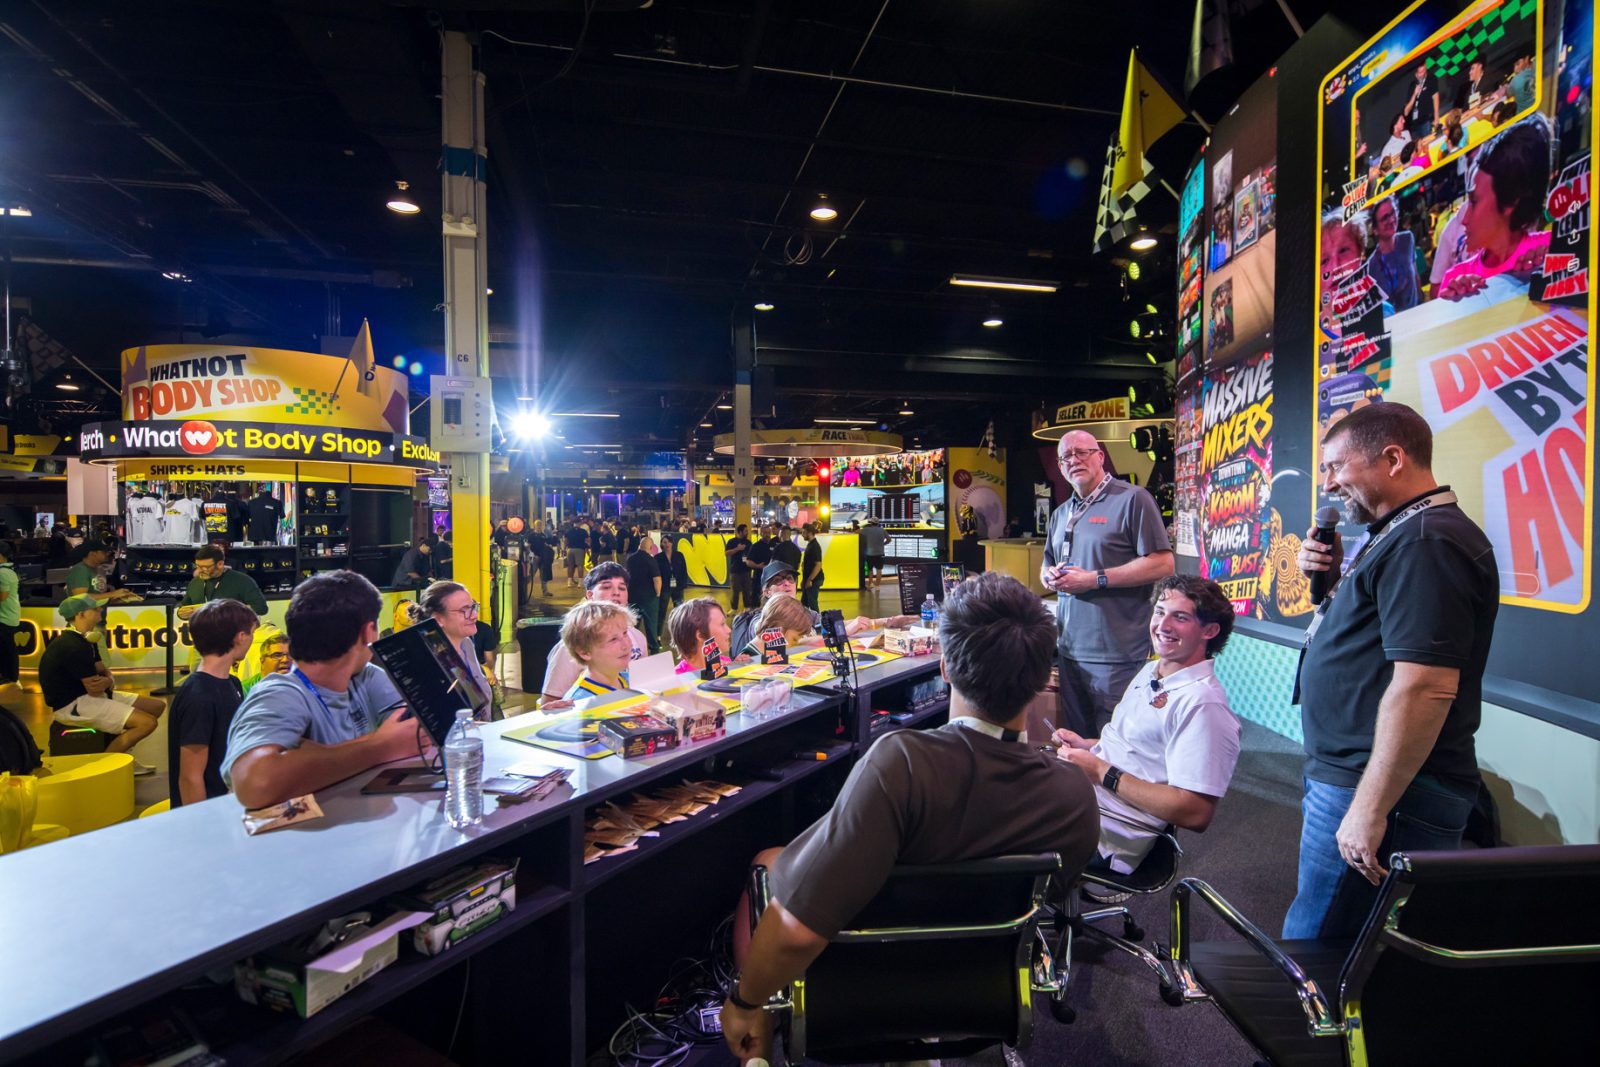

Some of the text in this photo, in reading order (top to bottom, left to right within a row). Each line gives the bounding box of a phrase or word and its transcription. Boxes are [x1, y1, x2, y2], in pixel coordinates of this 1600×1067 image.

[151, 354, 246, 382] WHATNOT
[457, 354, 469, 362] C6
[1429, 314, 1588, 414] DRIVEN
[132, 378, 283, 421] BODY SHOP
[1201, 353, 1273, 435] MASSIVE
[1494, 362, 1586, 436] BY
[1058, 398, 1125, 419] SELLER ZONE
[244, 429, 316, 454] Body
[321, 432, 382, 458] Shop
[822, 430, 848, 440] RACE
[1201, 392, 1273, 476] MIXERS
[150, 464, 246, 475] SHIRTS HATS
[1411, 499, 1431, 511] VIP
[1209, 523, 1249, 554] MANGA
[1231, 552, 1262, 577] BLAST
[1235, 580, 1255, 598] HIT
[41, 624, 194, 649] wtnot
